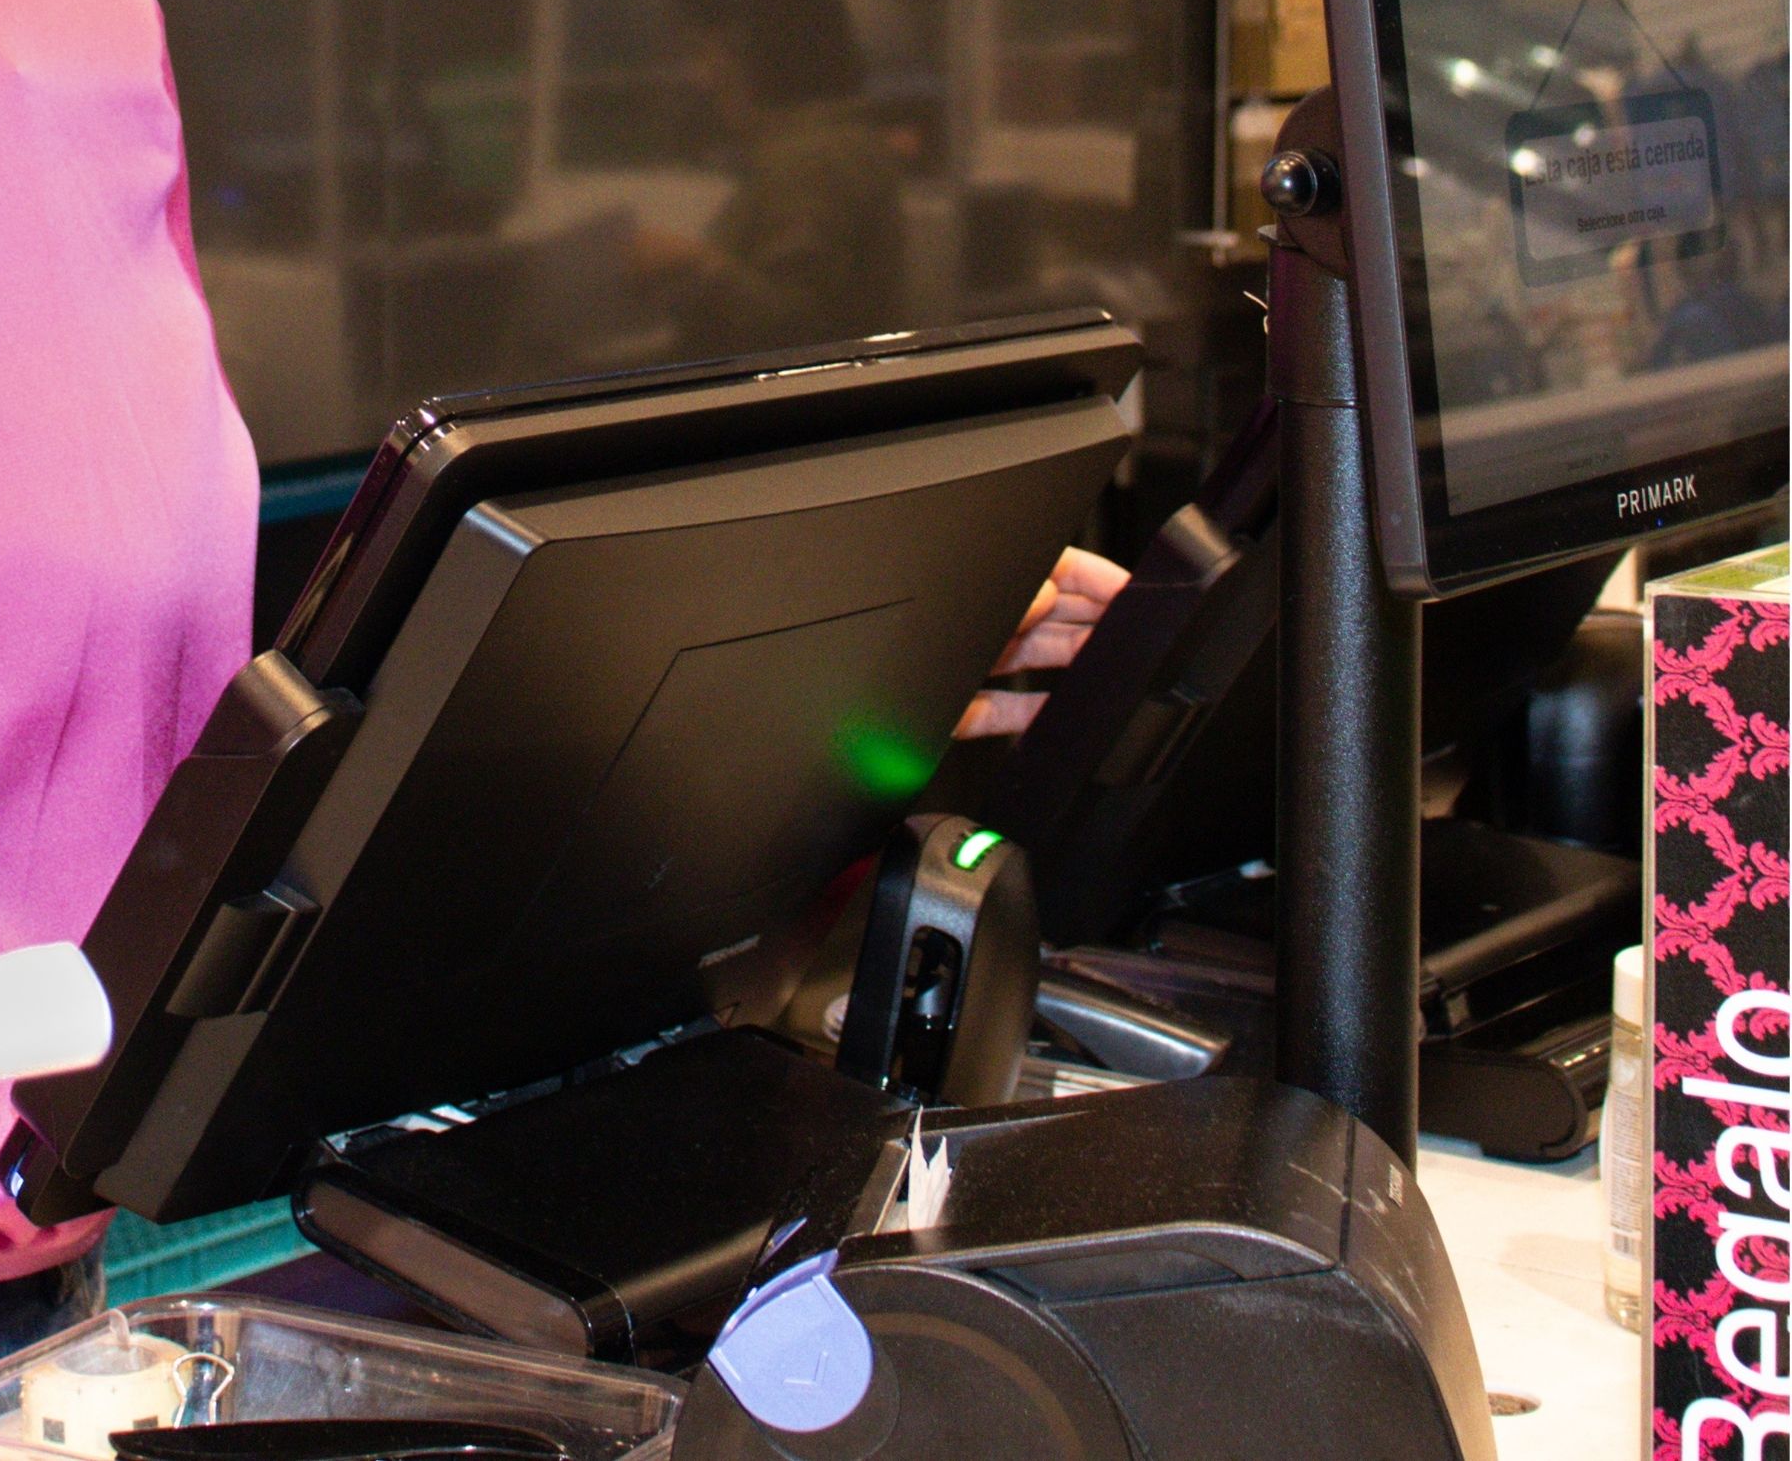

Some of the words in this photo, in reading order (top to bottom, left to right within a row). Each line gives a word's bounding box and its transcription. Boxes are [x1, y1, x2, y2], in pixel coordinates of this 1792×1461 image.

[1567, 148, 1601, 184] caja
[1645, 133, 1706, 166] cerrada
[1617, 474, 1698, 518] PRIMARK
